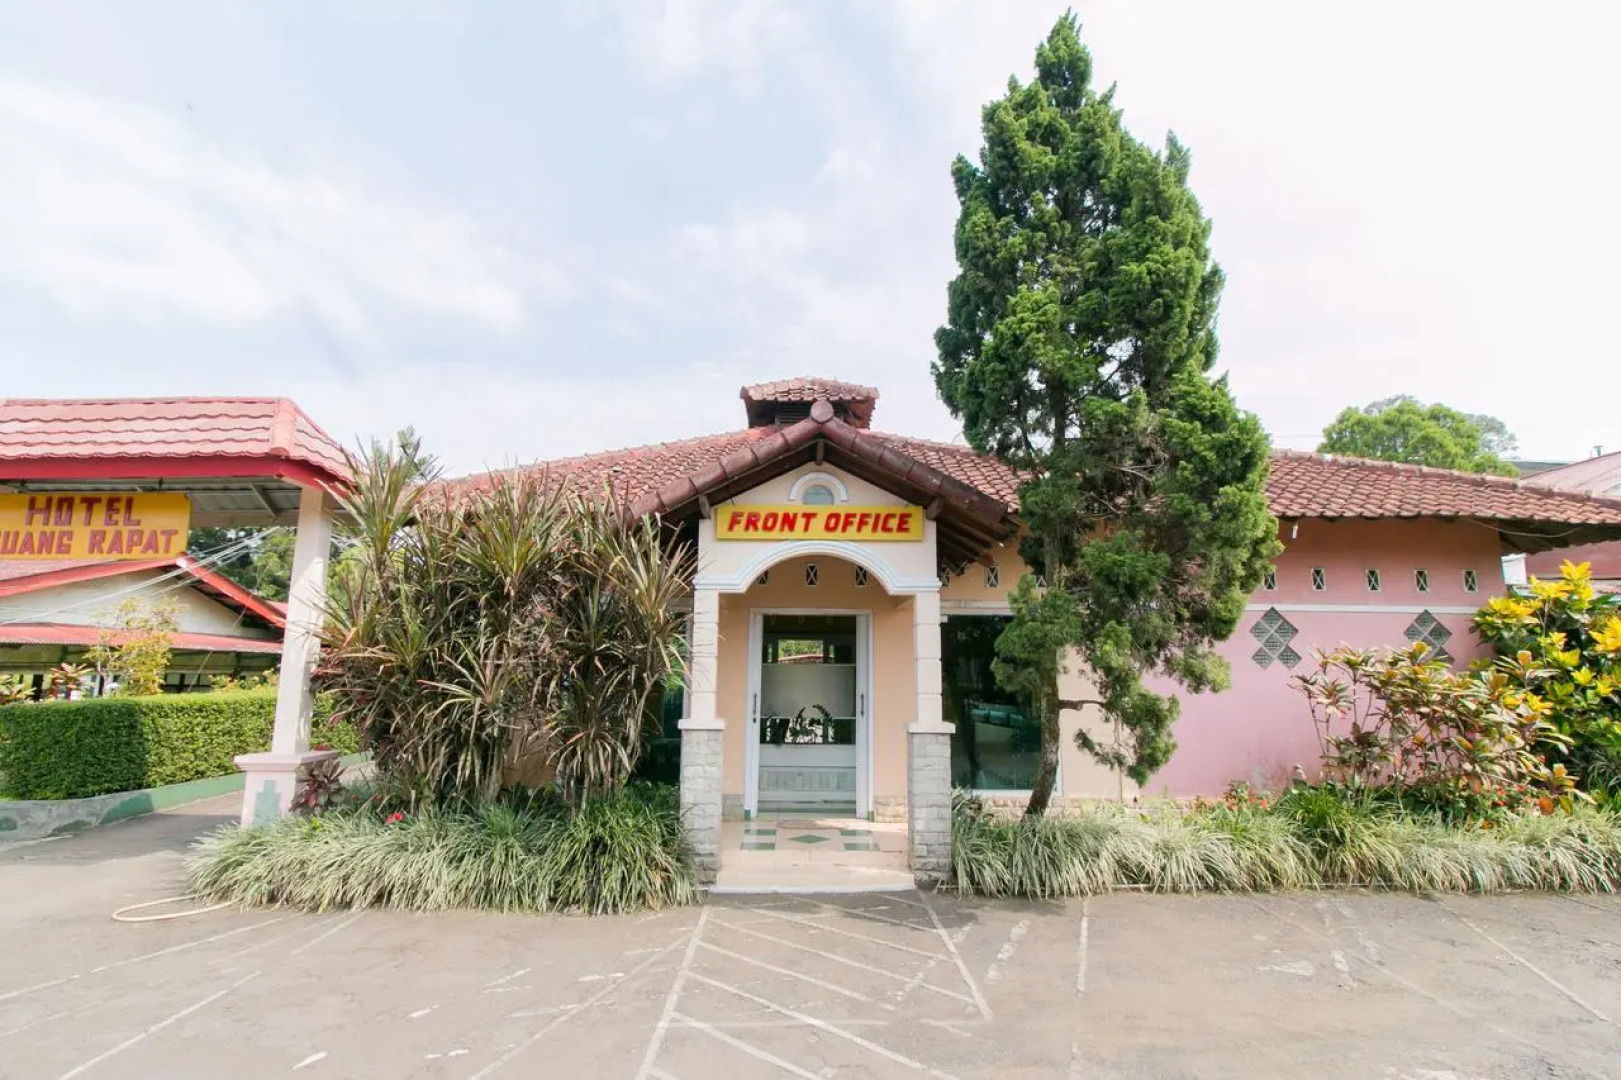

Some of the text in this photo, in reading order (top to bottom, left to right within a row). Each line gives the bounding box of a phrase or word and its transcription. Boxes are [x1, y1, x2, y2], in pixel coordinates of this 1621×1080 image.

[25, 496, 141, 526] HOTEL
[728, 511, 912, 534] FRONT OFFICE
[0, 528, 178, 555] UANG RAPAT
